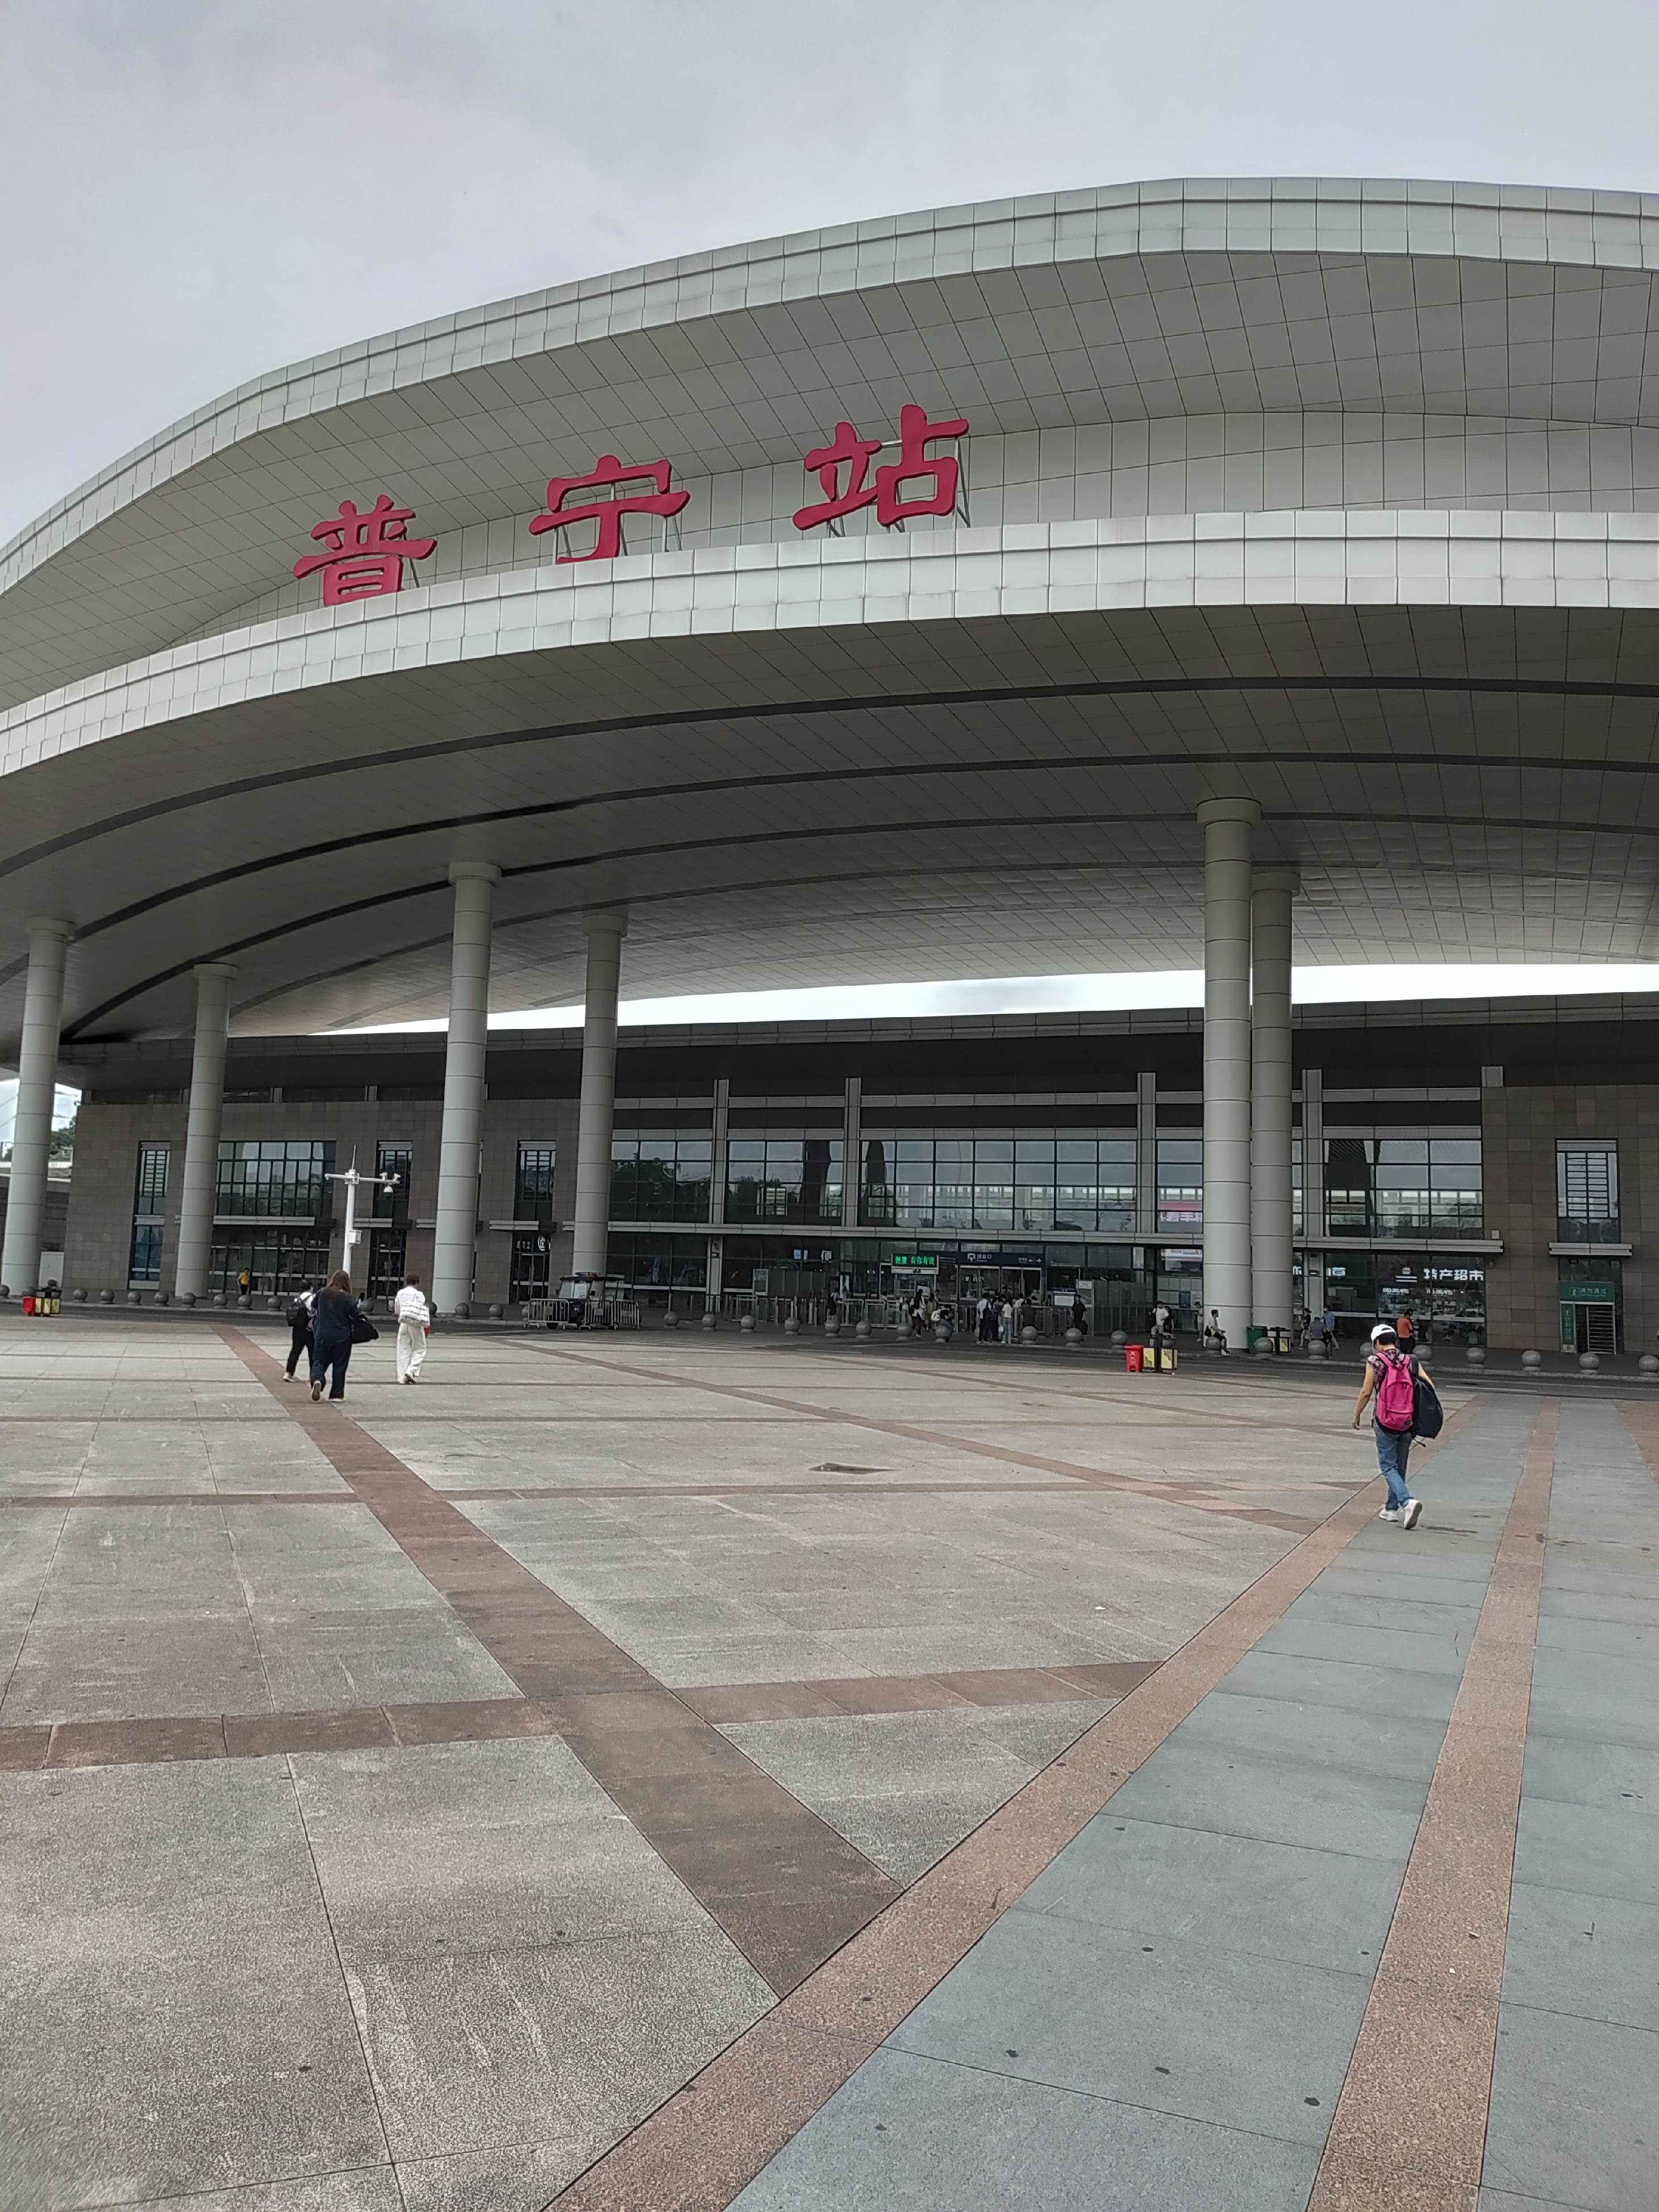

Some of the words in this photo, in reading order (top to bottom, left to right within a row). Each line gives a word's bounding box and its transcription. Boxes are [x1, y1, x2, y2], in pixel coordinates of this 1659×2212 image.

[294, 404, 968, 606] 普宁站
[1423, 1268, 1484, 1281] 特产超市
